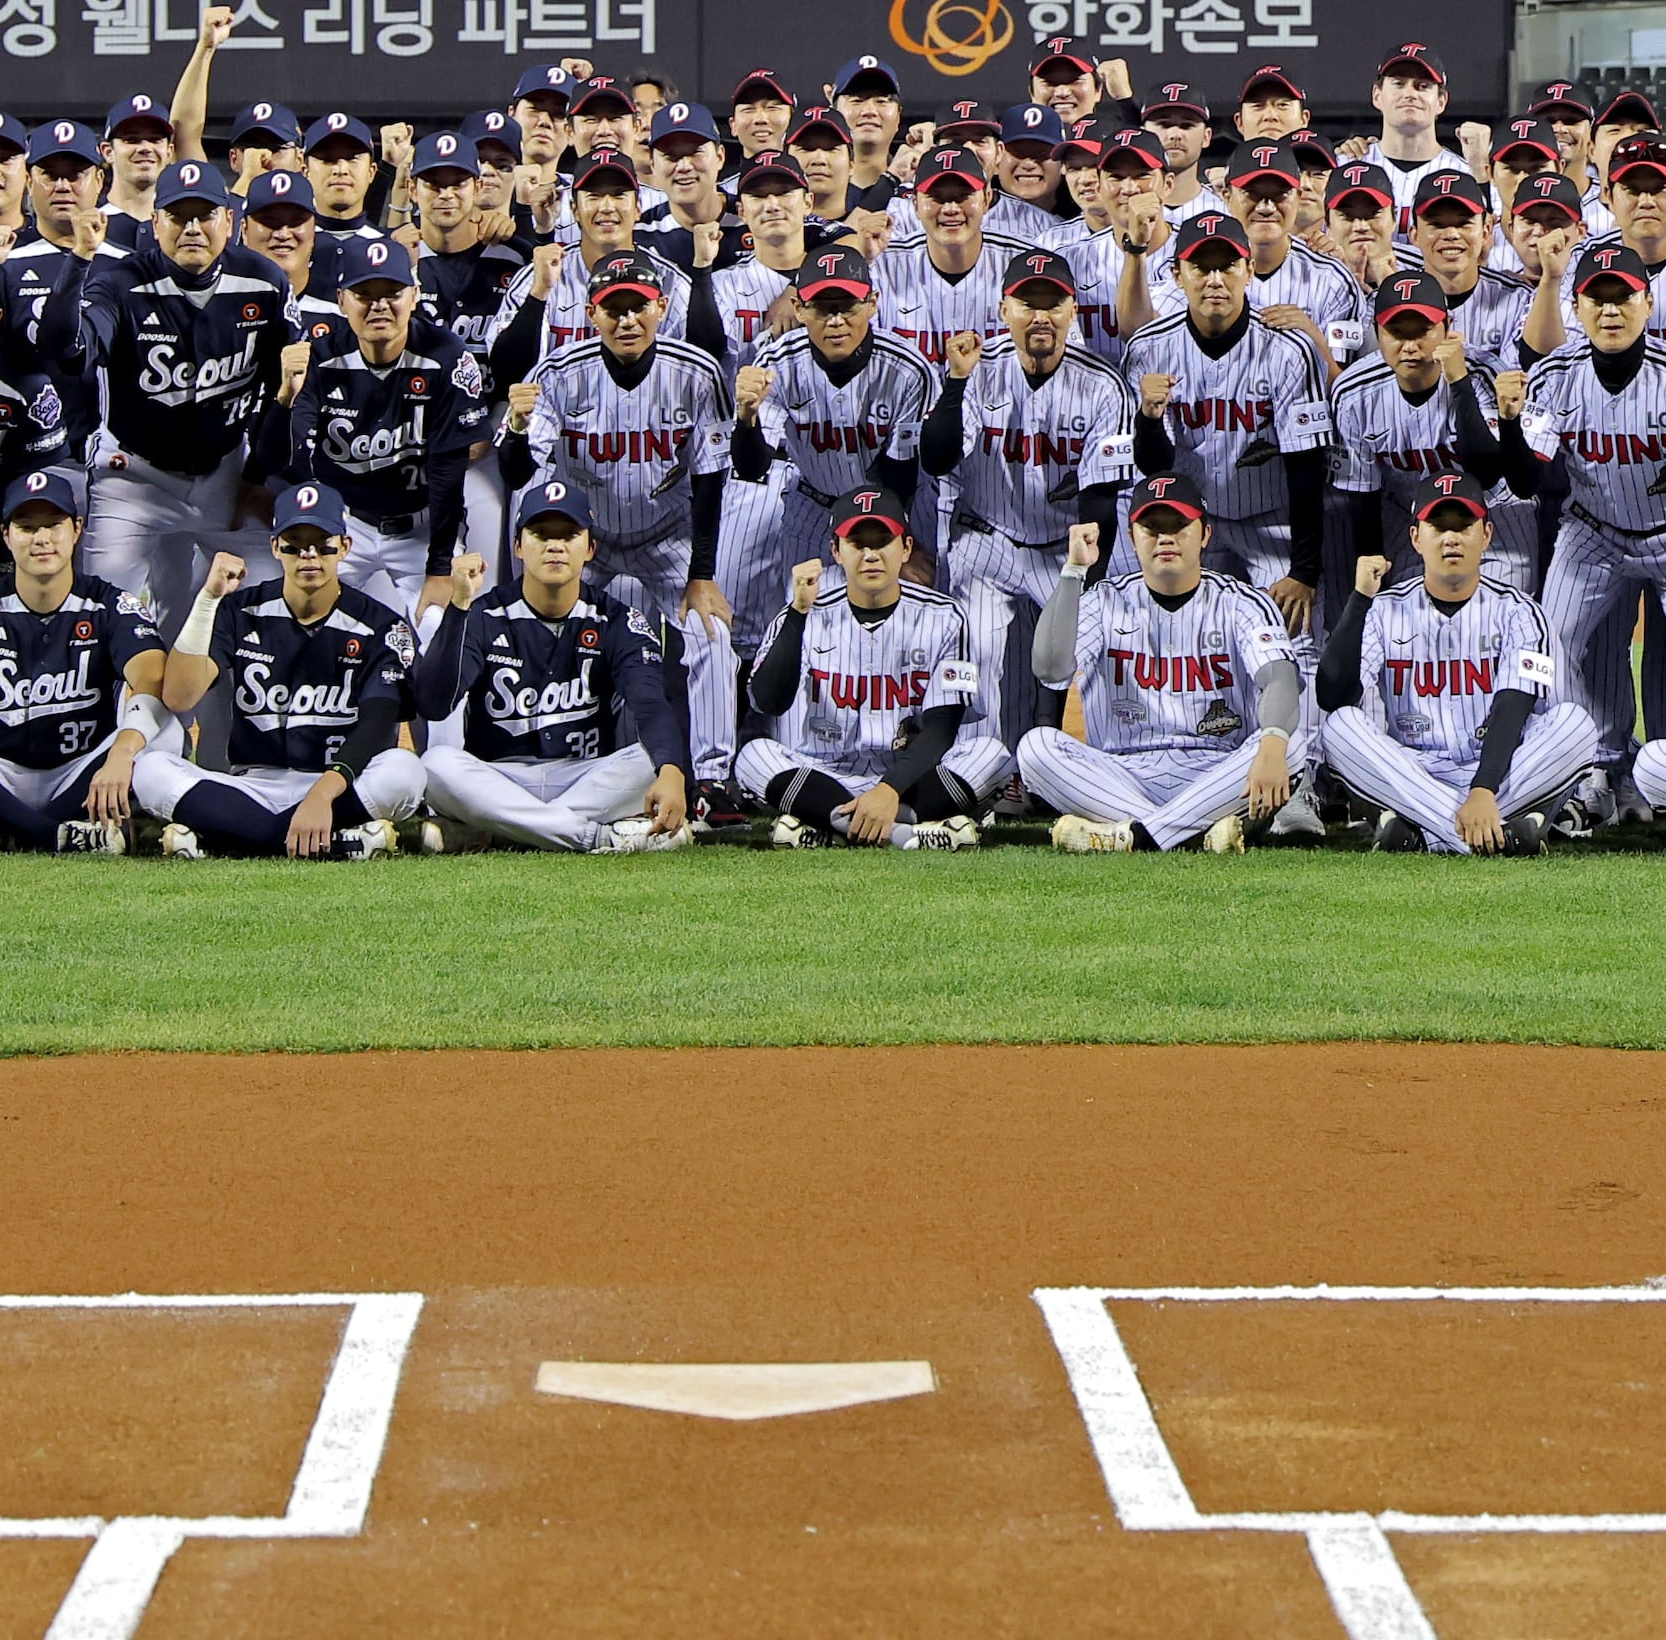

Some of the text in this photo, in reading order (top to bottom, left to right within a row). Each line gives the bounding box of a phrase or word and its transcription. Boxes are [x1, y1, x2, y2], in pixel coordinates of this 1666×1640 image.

[1252, 146, 1278, 167] T
[180, 163, 201, 187] D
[1197, 216, 1223, 235] T
[818, 253, 846, 276] T
[1027, 255, 1052, 274] T
[1594, 248, 1621, 269] T
[1394, 279, 1421, 300] T
[138, 334, 178, 342] DOOSAN
[1344, 331, 1359, 340] LG
[140, 332, 257, 392] Seoul
[660, 408, 688, 424] LG
[1058, 415, 1085, 432] LG
[322, 405, 426, 461] Seoul
[26, 471, 48, 492] D
[544, 481, 566, 503] D
[1147, 477, 1175, 498] T
[1434, 474, 1462, 496] T
[296, 486, 319, 510] D
[853, 491, 881, 512] T
[1199, 631, 1224, 649] LG
[896, 647, 925, 666] LG
[1108, 649, 1233, 692] TWINS
[1387, 658, 1500, 697] TWIN
[236, 663, 359, 718] Seoul
[486, 658, 598, 722] Seoul
[810, 668, 930, 710] TWINS
[59, 720, 98, 754] 37
[565, 728, 599, 759] 32
